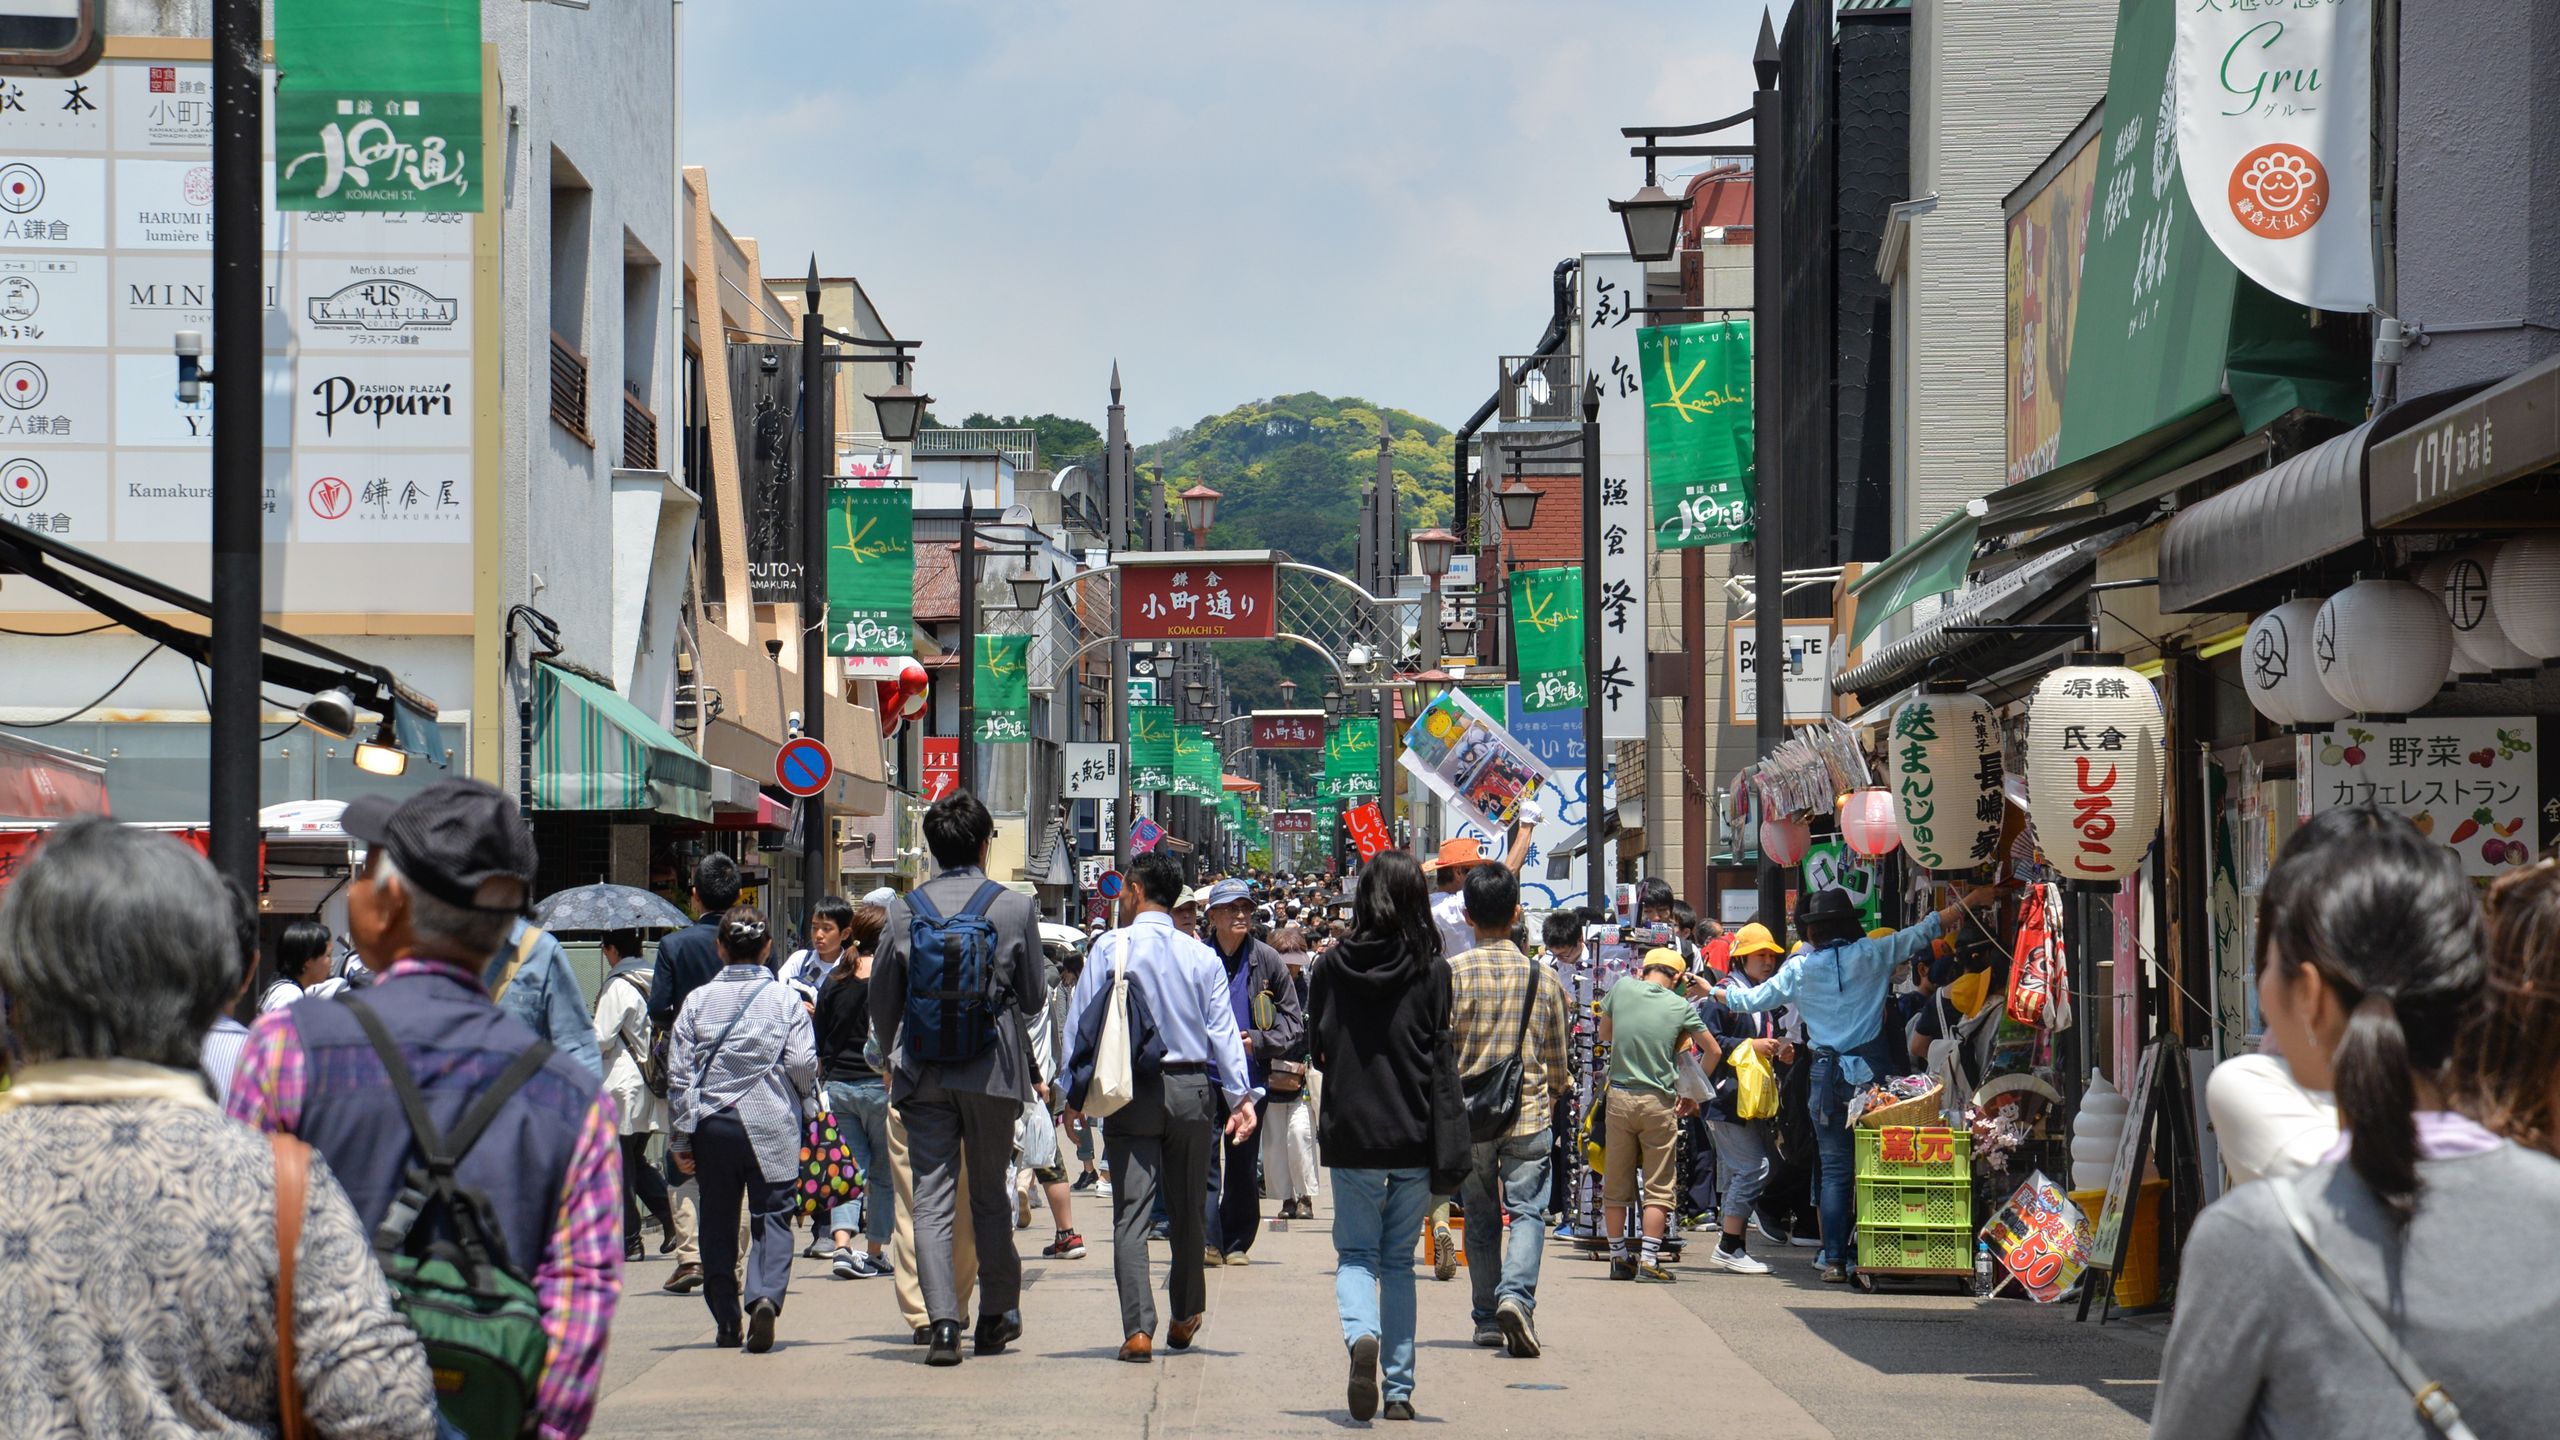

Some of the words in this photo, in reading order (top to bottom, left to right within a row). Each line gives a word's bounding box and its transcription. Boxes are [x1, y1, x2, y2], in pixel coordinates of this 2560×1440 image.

[2220, 21, 2322, 116] Gru
[357, 99, 400, 116] 鎌倉
[2263, 103, 2317, 119] グルー
[346, 189, 399, 201] KOMACHI
[402, 190, 417, 201] ST.
[139, 212, 201, 224] HARUMI
[2236, 192, 2321, 231] 鎌倉大仏パン
[146, 229, 199, 242] lumière
[350, 266, 377, 275] Men's
[378, 266, 386, 275] &
[319, 302, 449, 320] KAMAKURA
[1643, 332, 1745, 349] KAMAKURA
[360, 385, 405, 393] FASHION
[361, 478, 459, 513] 鎌倉屋
[1171, 571, 1222, 587] 鎌倉
[1140, 588, 1254, 621] 小町通り
[1167, 625, 1213, 635] KOMACHI
[1214, 625, 1227, 635] ST.
[1262, 727, 1316, 740] 小町通り
[1971, 710, 1990, 752] 和菓子
[923, 753, 958, 766] LFI
[2389, 736, 2461, 768] 野菜
[2332, 780, 2521, 806] カフェレストラン
[2072, 756, 2118, 873] しるこ
[1882, 1127, 1953, 1161] 窯元
[2009, 1231, 2064, 1289] 50
